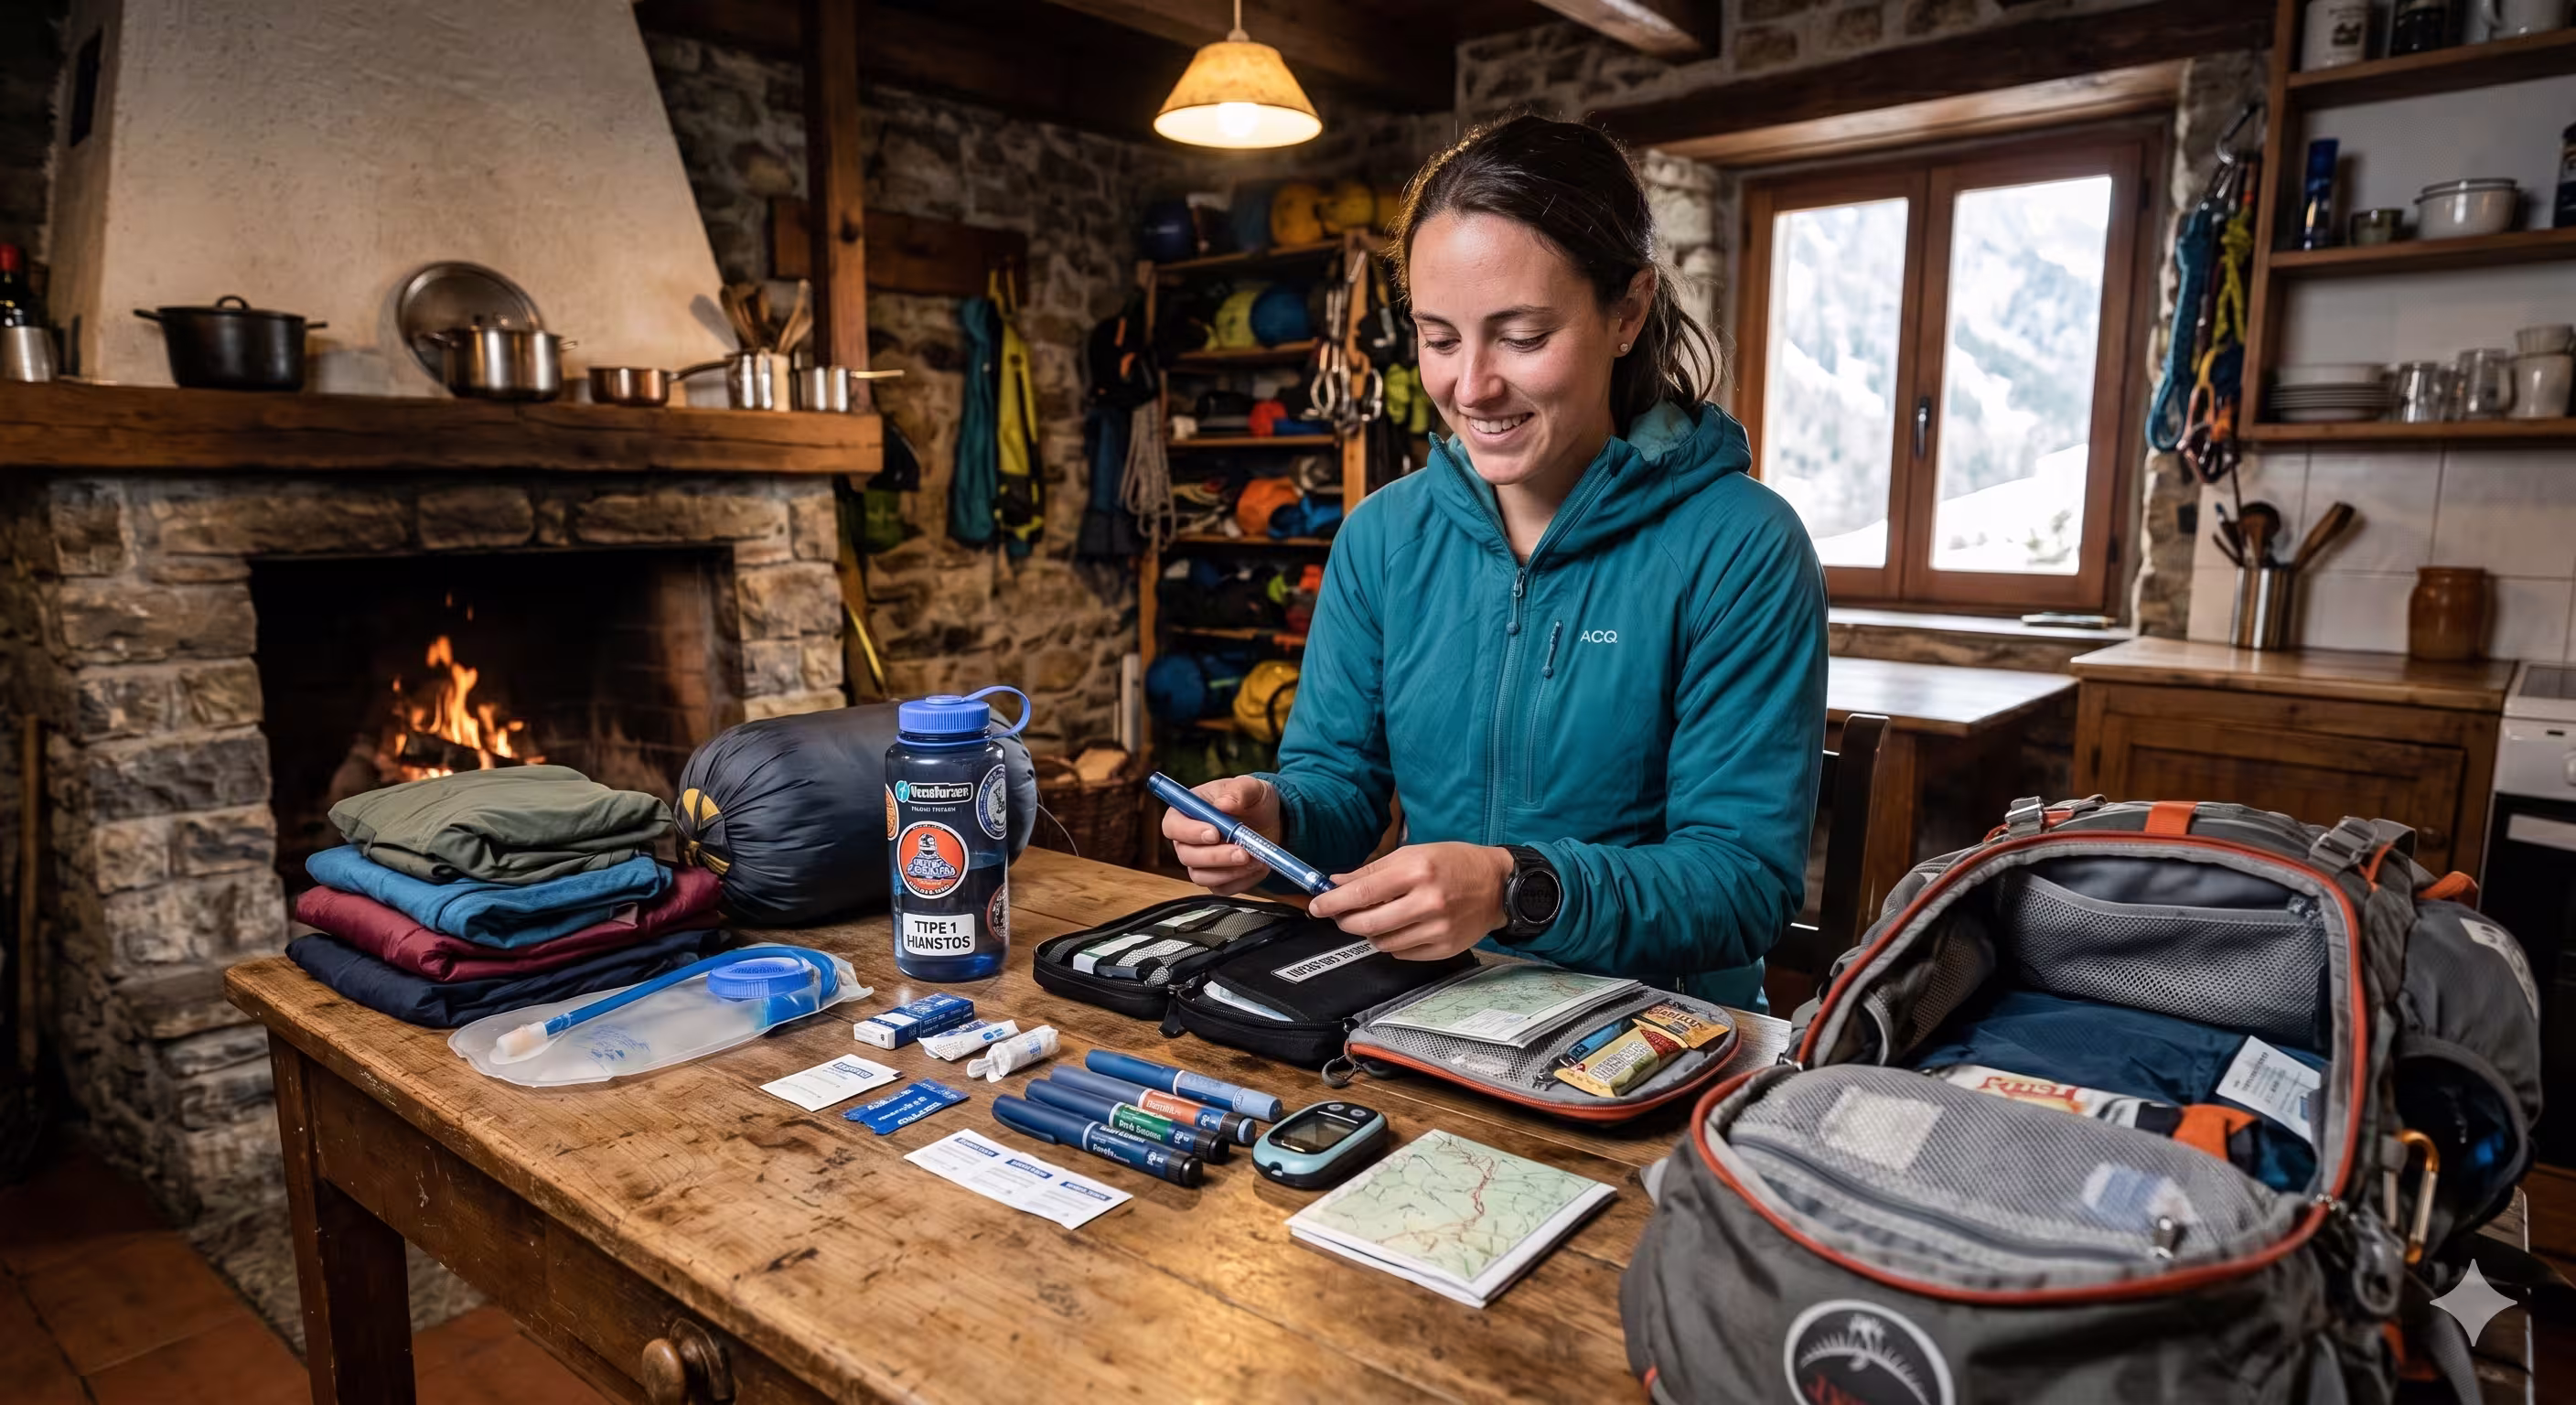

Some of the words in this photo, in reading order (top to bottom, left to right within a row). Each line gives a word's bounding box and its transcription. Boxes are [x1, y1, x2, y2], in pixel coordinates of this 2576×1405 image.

[1580, 630, 1617, 643] ACQ
[915, 920, 947, 934] TTPE
[950, 922, 956, 934] 1
